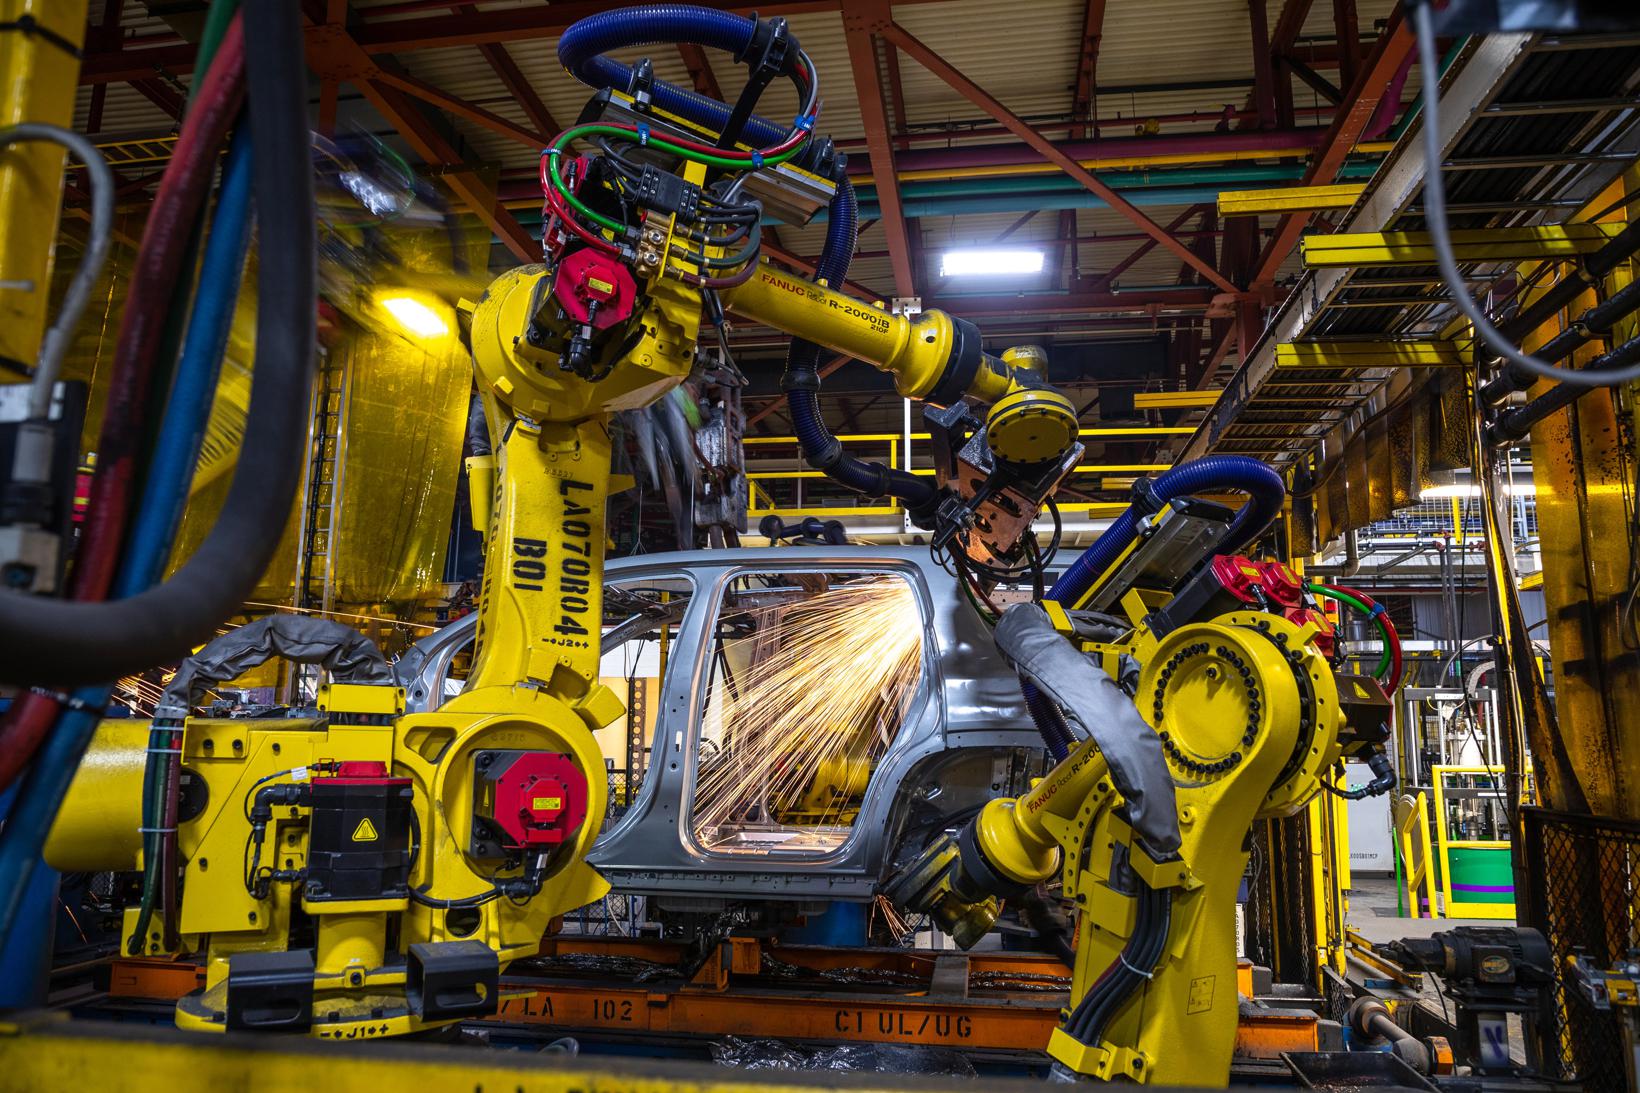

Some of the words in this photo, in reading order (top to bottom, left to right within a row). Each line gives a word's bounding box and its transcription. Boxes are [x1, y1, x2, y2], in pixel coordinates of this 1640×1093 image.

[762, 273, 806, 296] FANUC
[554, 479, 594, 636] LA070R04
[1028, 784, 1058, 814] FANUC
[593, 999, 633, 1022] 102
[835, 1010, 863, 1033] C1
[879, 1012, 972, 1039] UL/UG
